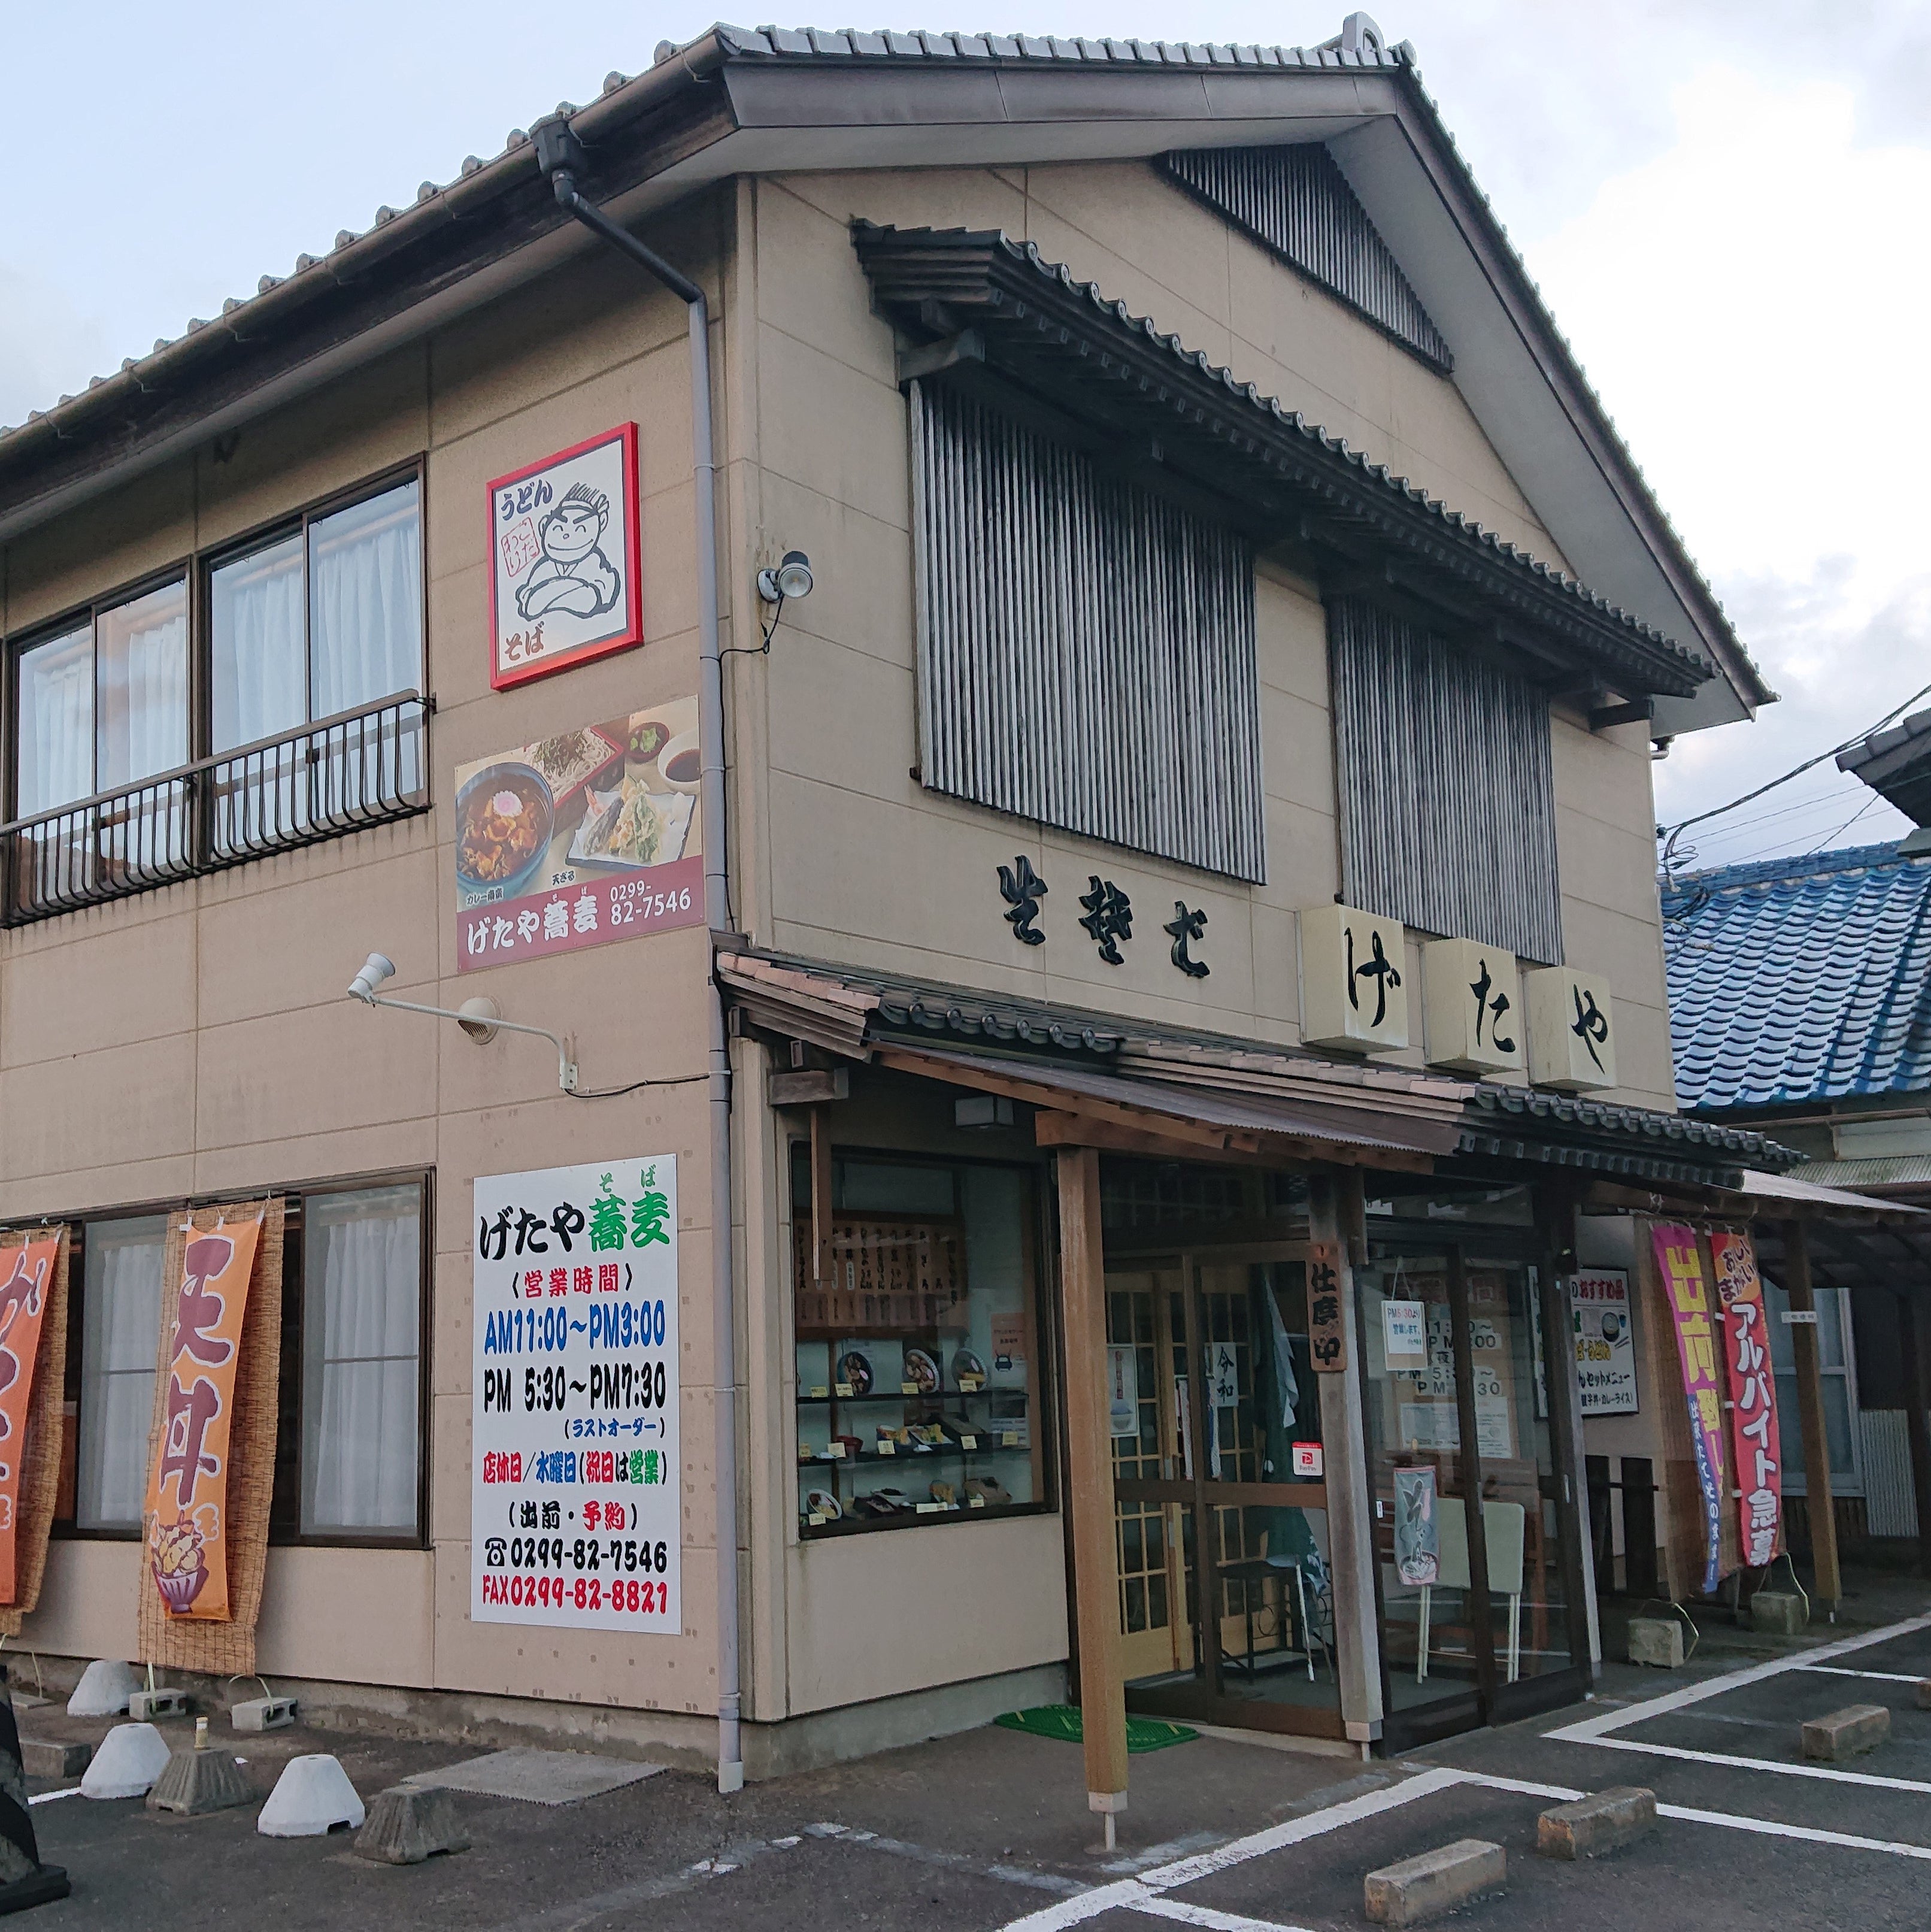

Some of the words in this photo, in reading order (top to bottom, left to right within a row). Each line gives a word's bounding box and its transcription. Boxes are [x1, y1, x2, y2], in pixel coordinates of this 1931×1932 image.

[501, 479, 553, 521] うどん
[505, 621, 545, 661] そば
[552, 870, 575, 886] 天ざる
[610, 879, 651, 903] 0299-
[467, 894, 599, 956] げたや蕎麦
[610, 887, 692, 926] 82-7546
[1344, 926, 1608, 1076] げたや
[599, 1164, 656, 1193] そば
[479, 1190, 670, 1261] げたや蕎麦
[1216, 1346, 1235, 1404] 令和
[1730, 1303, 1778, 1567] アルバイト急募
[510, 1537, 668, 1573] 0299-82-7546
